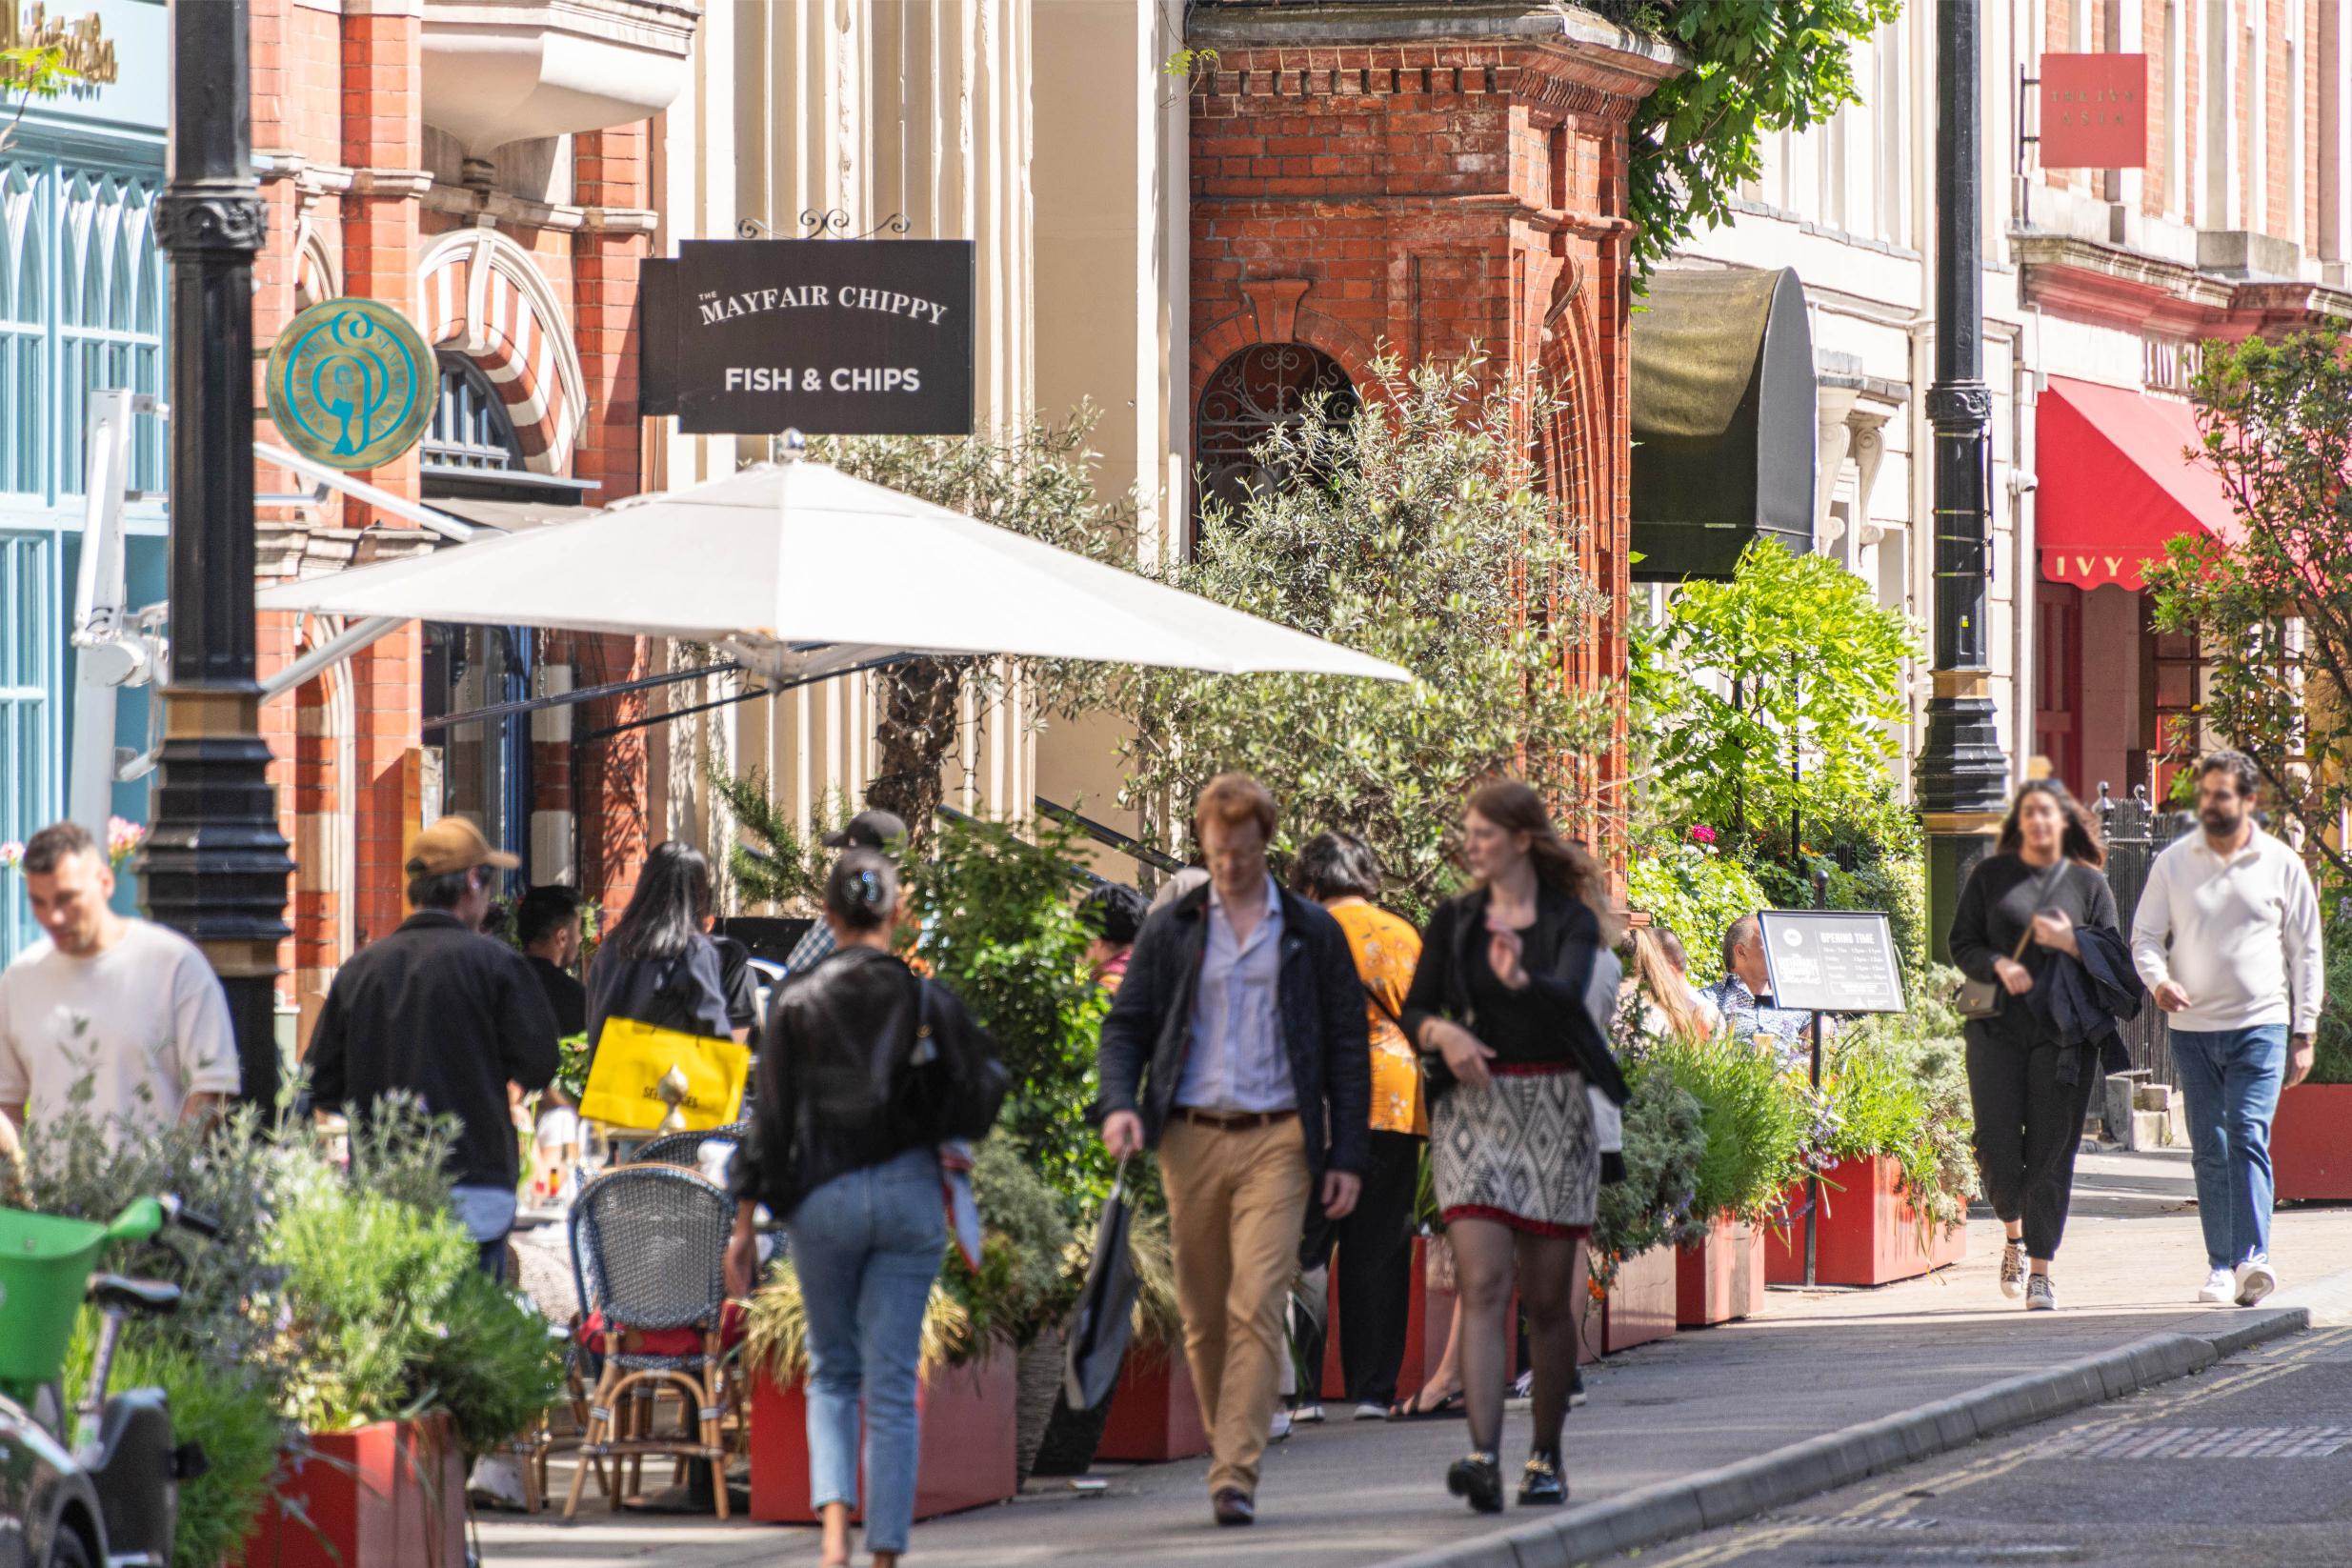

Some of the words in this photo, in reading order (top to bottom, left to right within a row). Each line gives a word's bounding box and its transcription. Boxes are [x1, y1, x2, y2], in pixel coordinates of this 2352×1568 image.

[2061, 111, 2125, 127] ASIA
[698, 291, 717, 301] THE
[698, 285, 830, 326] MAYFAIR
[838, 286, 948, 326] CHIPPY
[725, 368, 793, 392] FISH
[801, 368, 822, 392] &
[830, 368, 920, 392] CHIPS
[2057, 556, 2123, 577] IVY
[1820, 933, 1853, 944] OPENING
